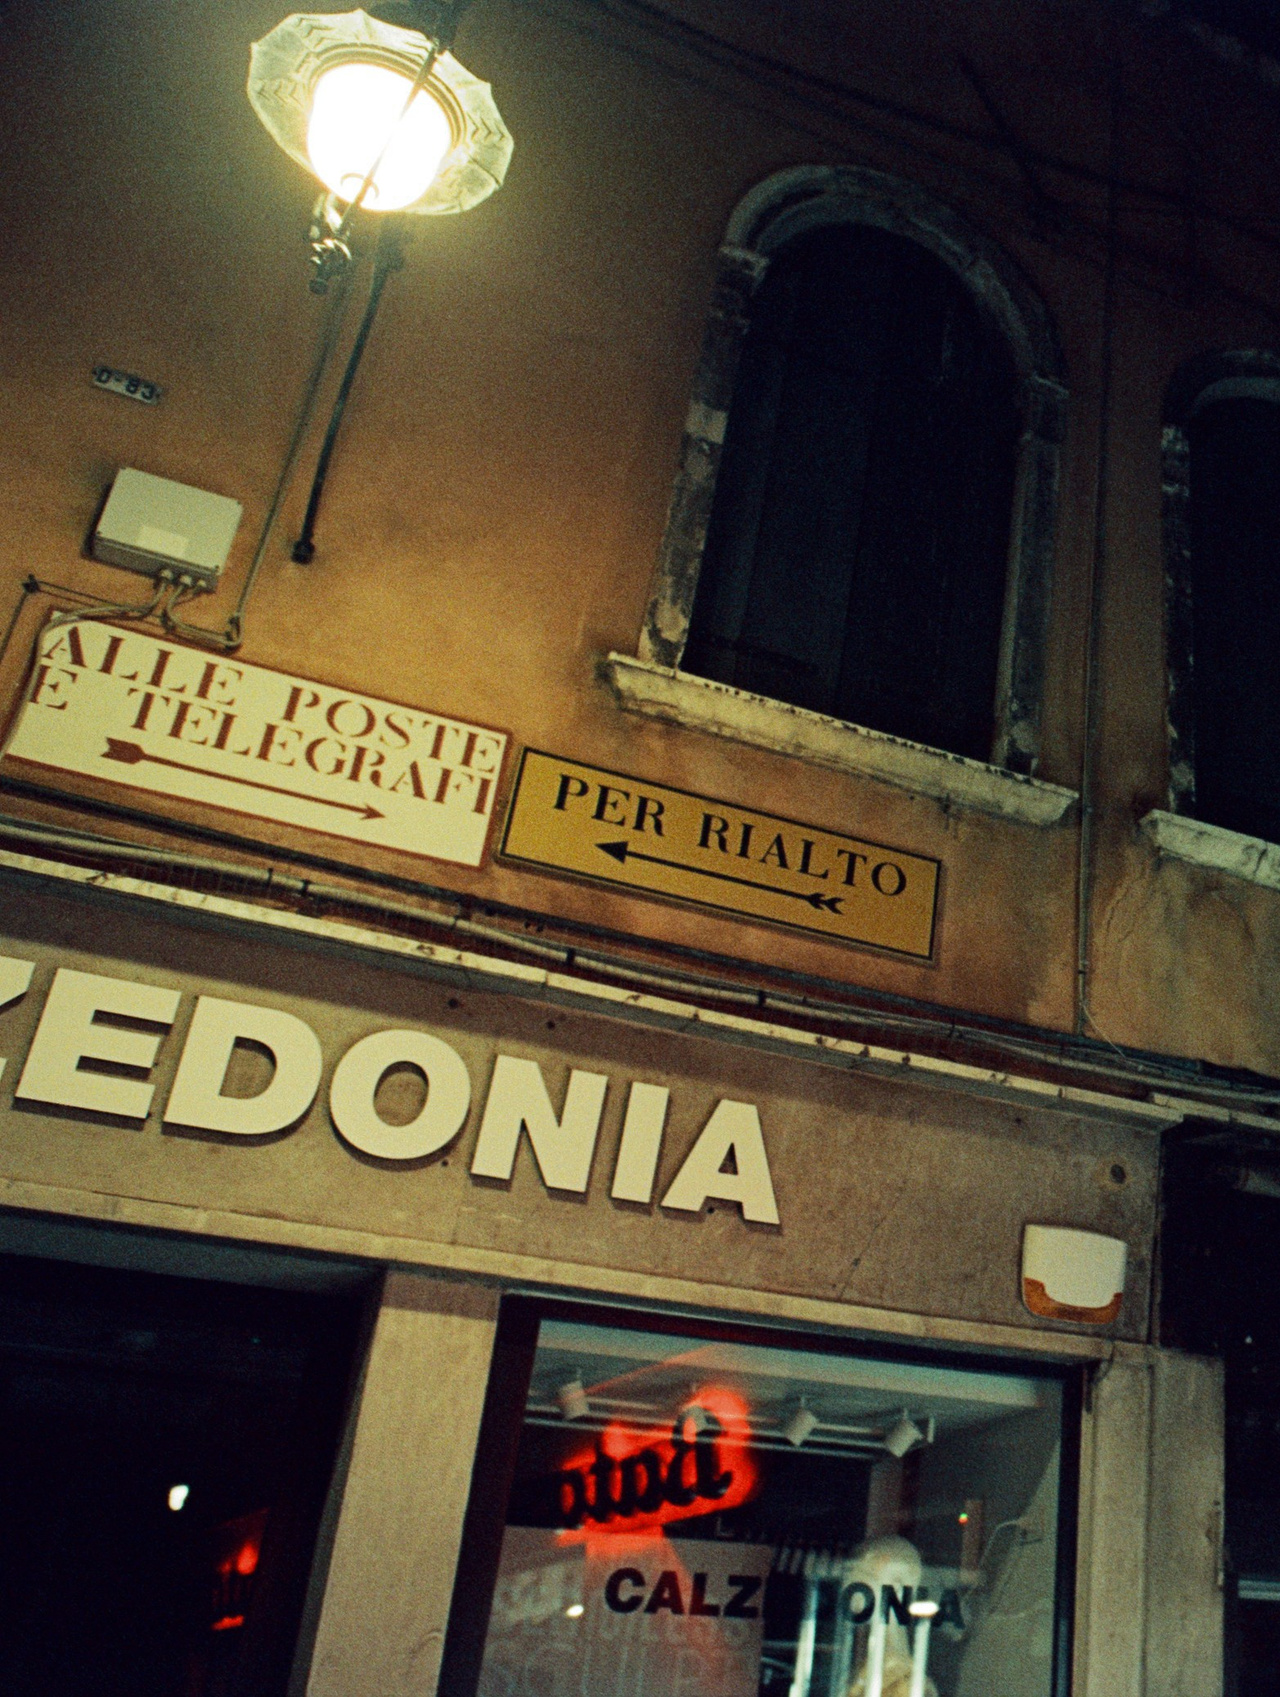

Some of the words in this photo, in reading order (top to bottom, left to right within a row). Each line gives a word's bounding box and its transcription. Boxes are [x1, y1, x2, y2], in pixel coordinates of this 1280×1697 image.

[31, 664, 80, 712] E
[127, 686, 493, 815] TELEGRAFI
[42, 626, 243, 710] ALLE
[282, 685, 503, 774] POSTE
[552, 772, 667, 837] PER
[697, 812, 908, 897] RIALTO
